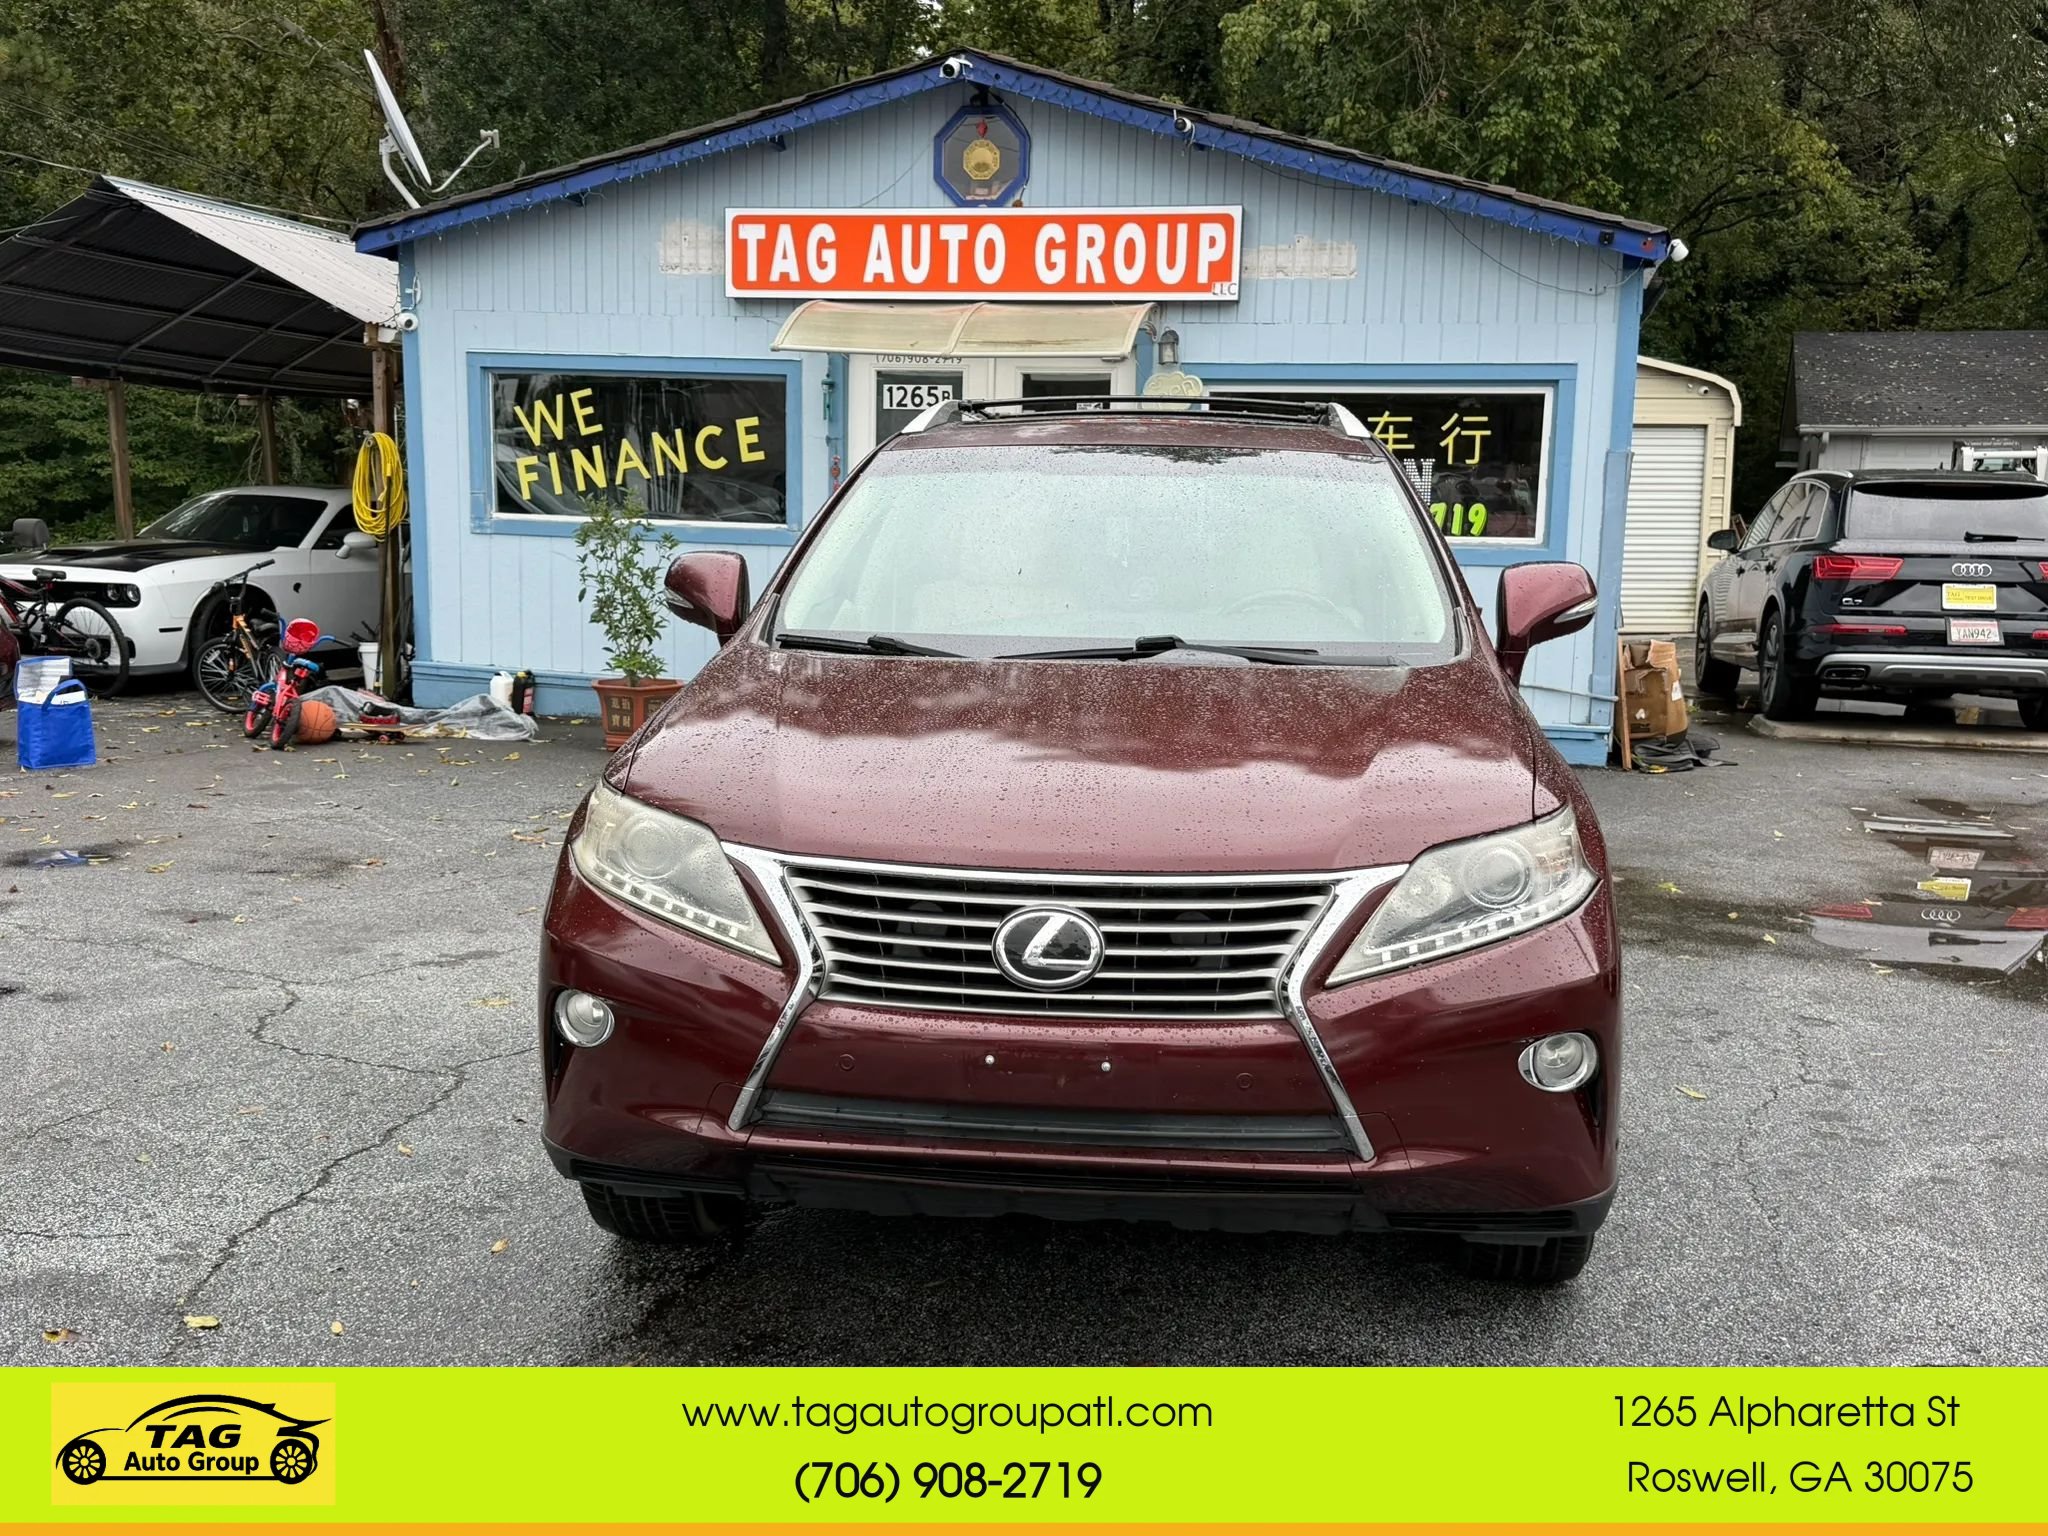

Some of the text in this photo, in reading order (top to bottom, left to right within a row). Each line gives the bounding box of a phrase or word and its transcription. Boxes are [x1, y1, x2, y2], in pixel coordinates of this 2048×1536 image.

[738, 222, 1227, 285] TAG AUTO GROUP
[1212, 282, 1238, 296] LLC
[513, 388, 603, 447] WE
[516, 416, 766, 500] FINANCE
